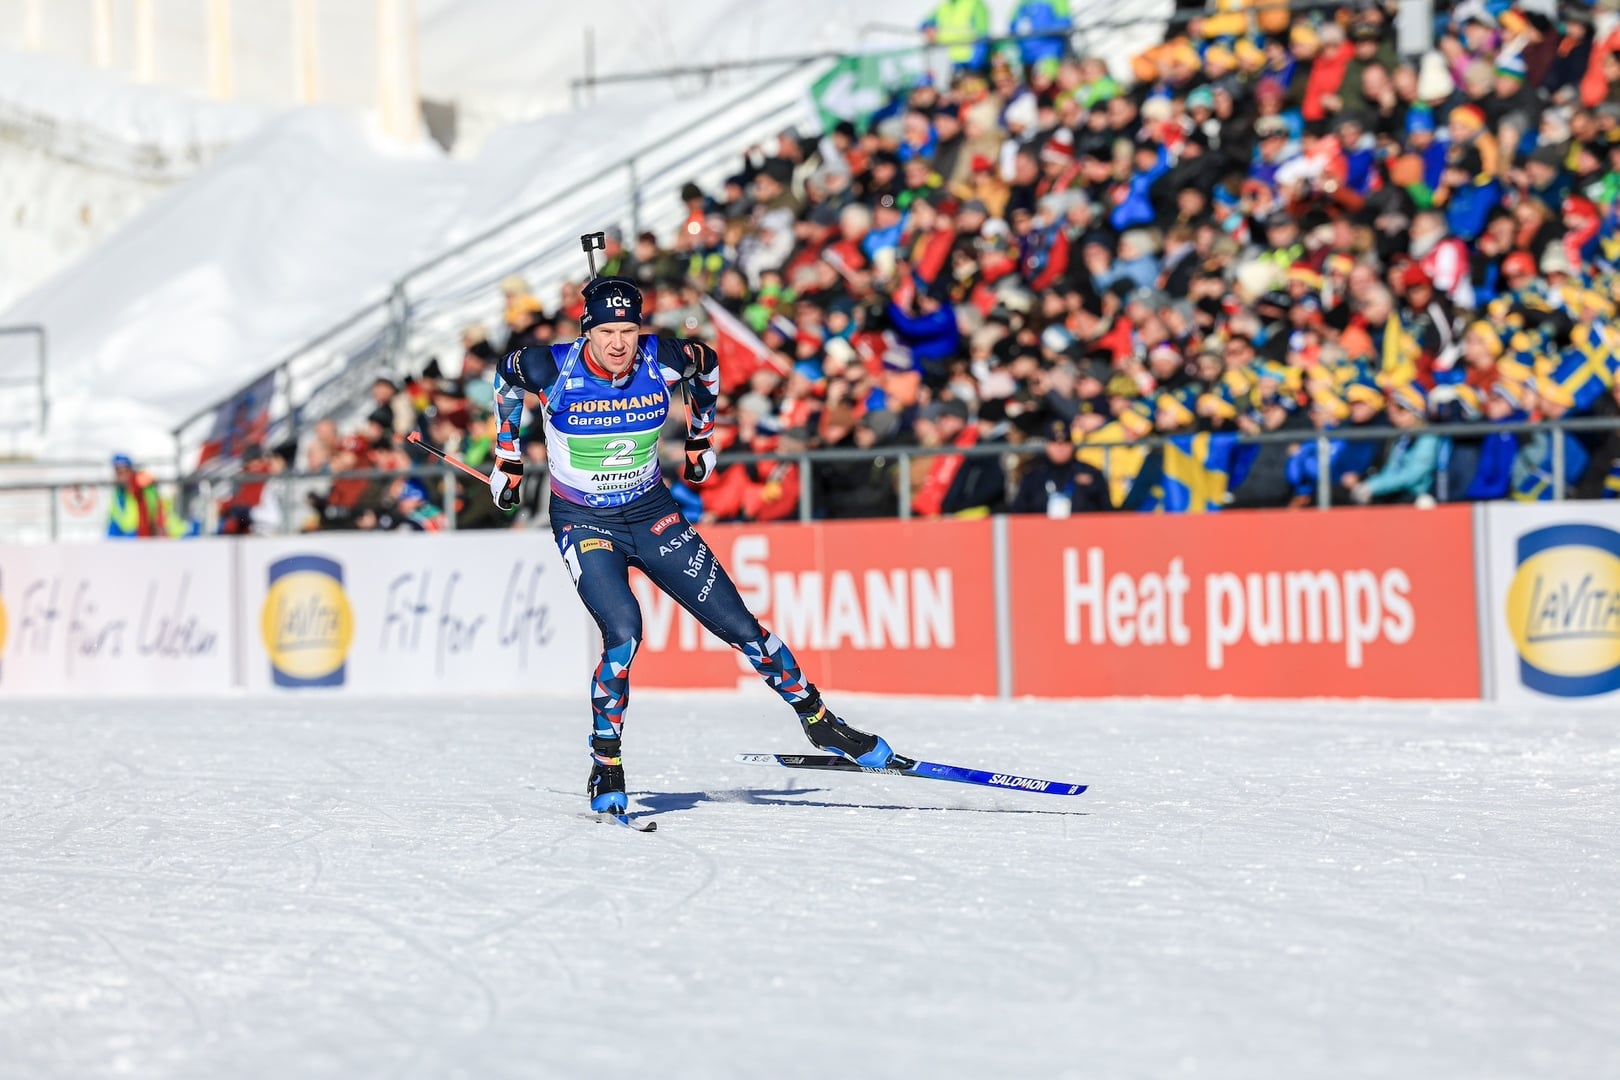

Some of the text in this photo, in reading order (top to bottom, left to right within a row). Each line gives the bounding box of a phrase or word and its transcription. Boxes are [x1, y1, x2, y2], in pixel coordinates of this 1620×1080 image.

[567, 407, 665, 427] Garage Doors
[601, 438, 638, 467] 2
[591, 465, 648, 482] ANTHOLZ
[654, 515, 677, 532] MENY
[697, 561, 718, 602] CRAFT
[1063, 547, 1415, 670] Heat pumps
[379, 570, 430, 652] Fit
[434, 571, 486, 679] for
[988, 774, 1051, 792] SALOMON
